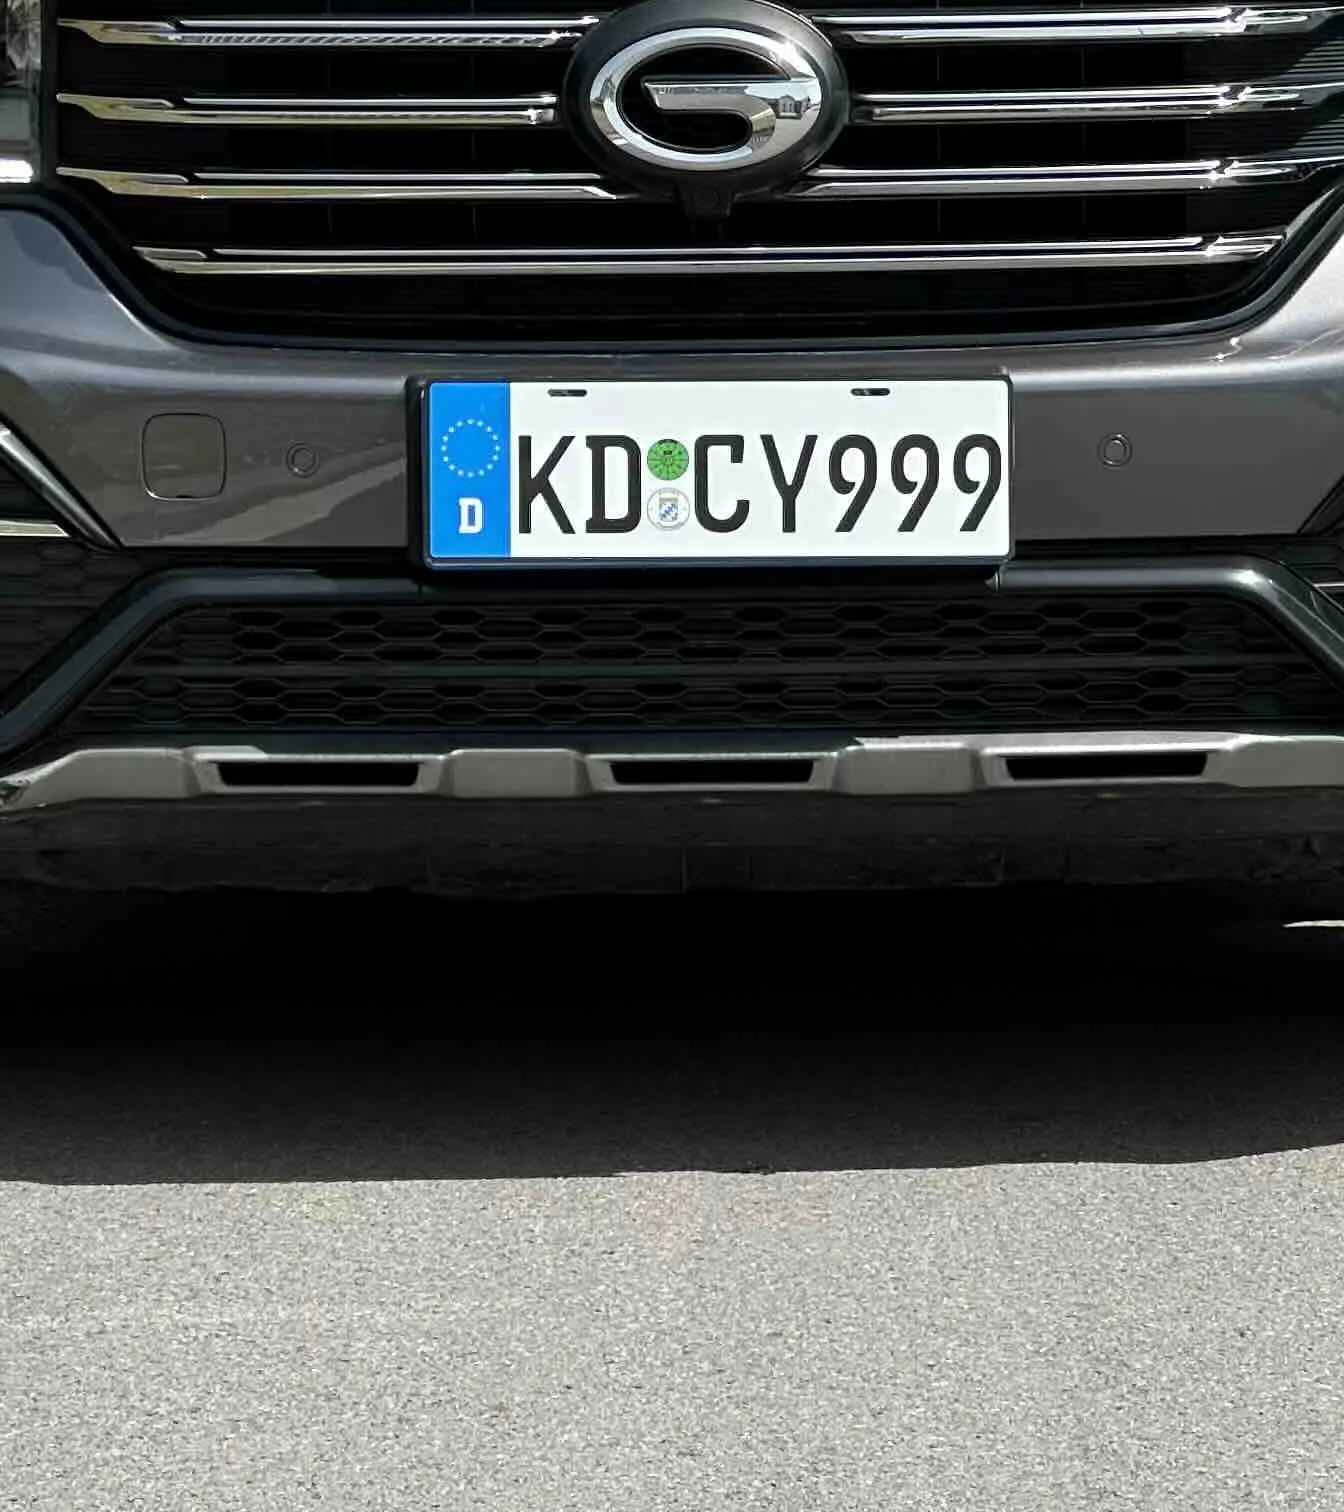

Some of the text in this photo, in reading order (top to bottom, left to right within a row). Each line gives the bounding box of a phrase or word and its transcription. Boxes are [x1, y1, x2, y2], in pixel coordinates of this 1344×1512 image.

[458, 498, 483, 534] D
[518, 433, 1002, 535] KD CY999
